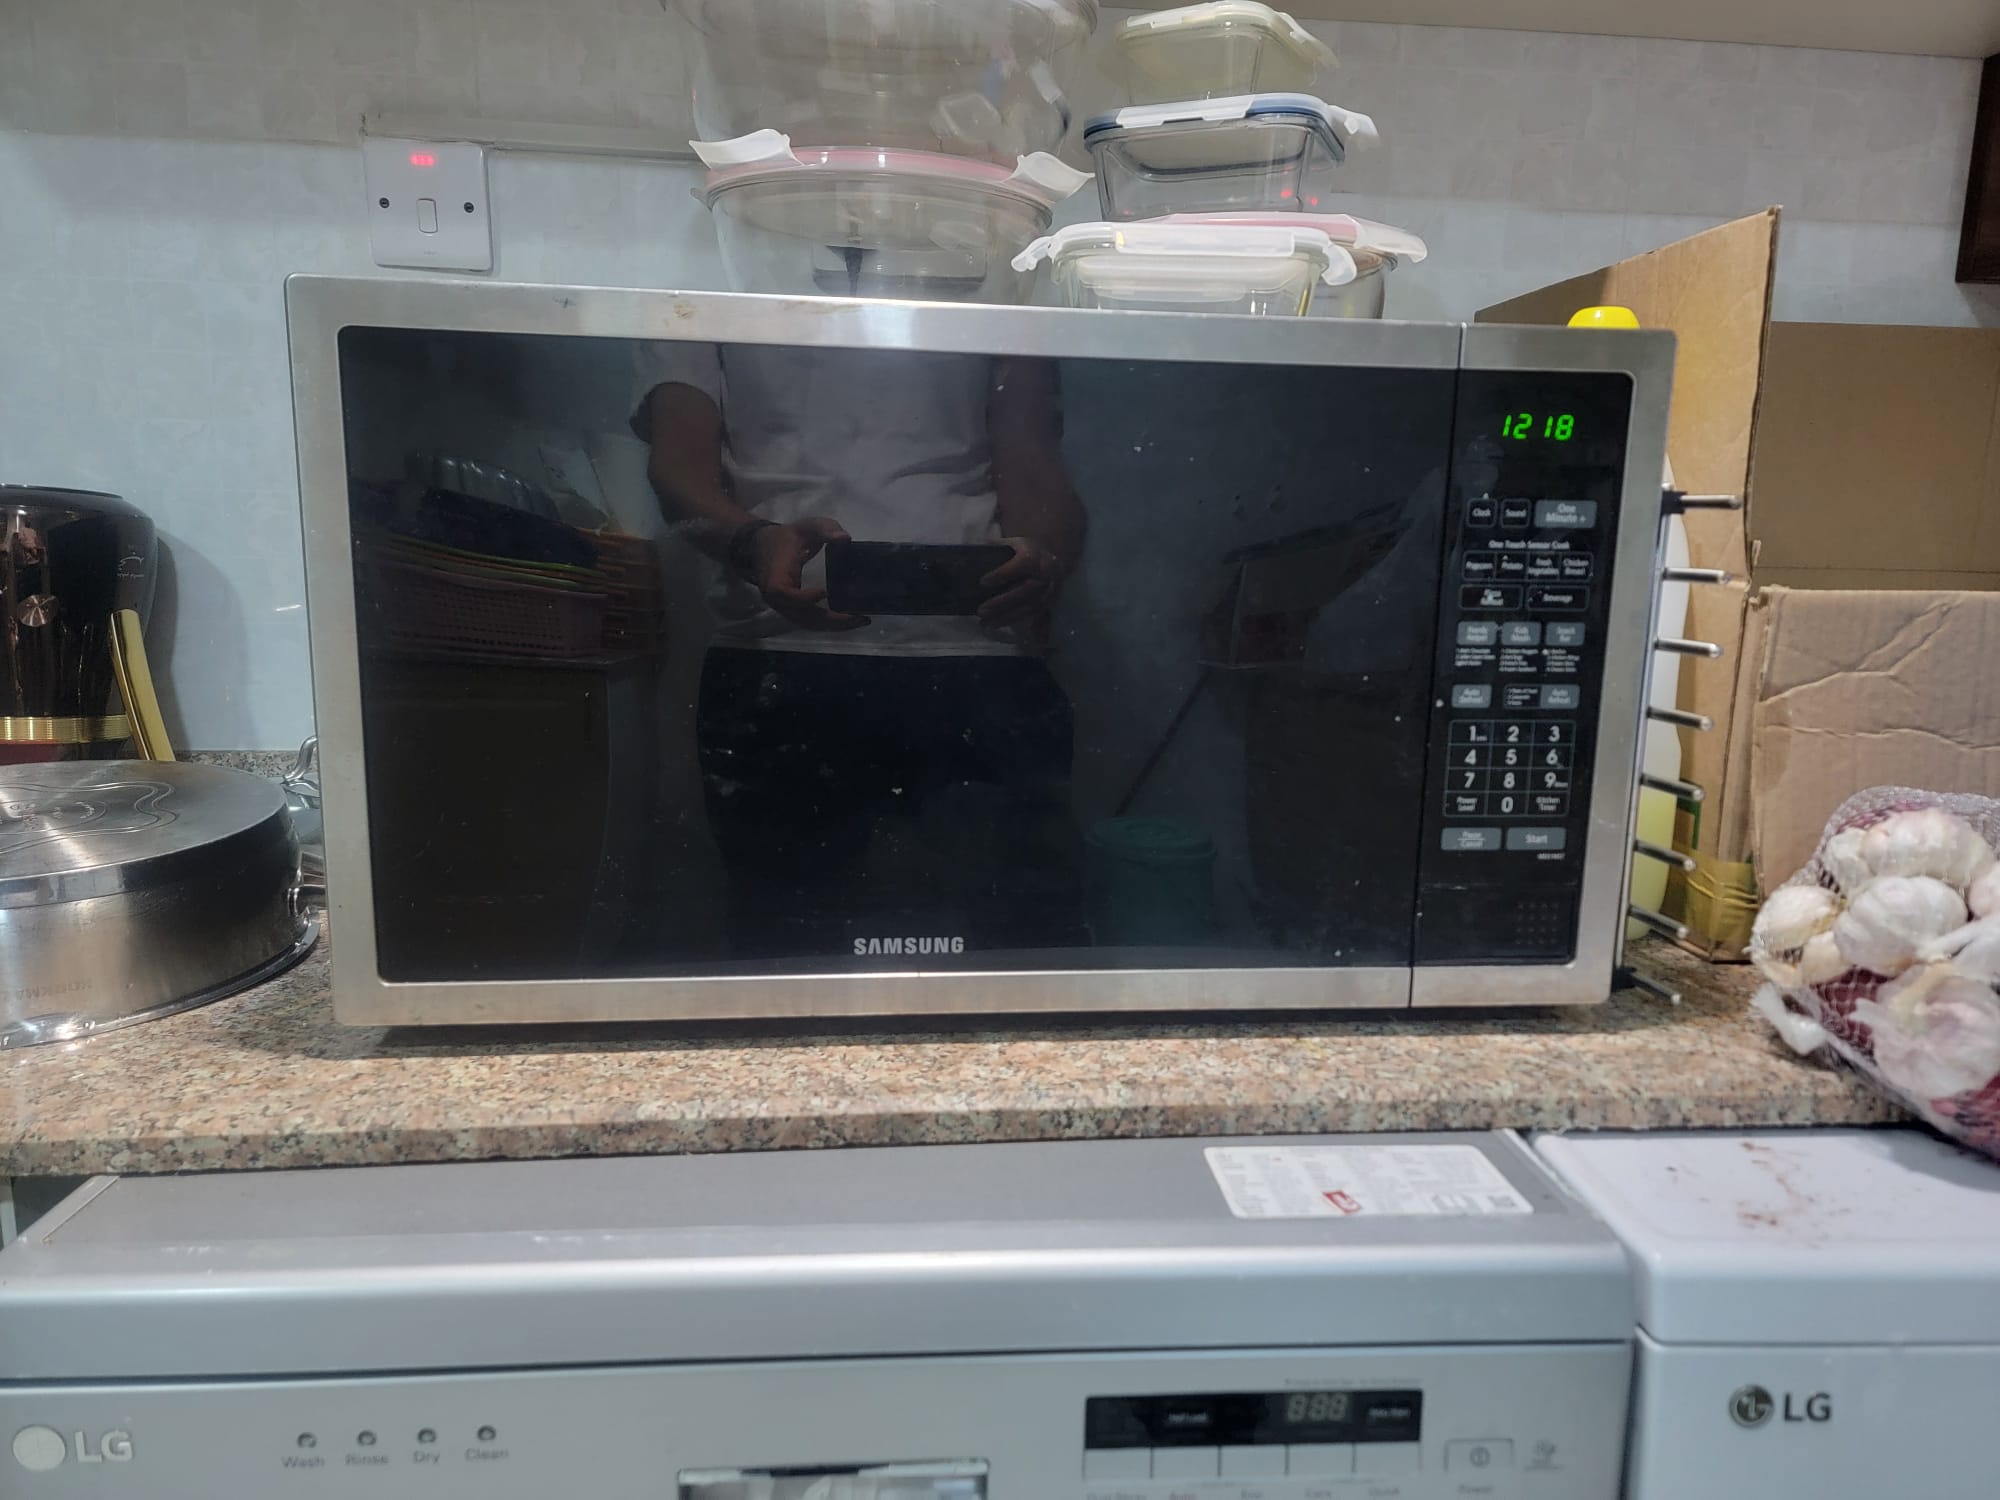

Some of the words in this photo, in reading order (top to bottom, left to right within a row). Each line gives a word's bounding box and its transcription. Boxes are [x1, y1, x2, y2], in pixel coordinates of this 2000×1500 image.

[1558, 503, 1577, 513] One
[1545, 512, 1578, 523] Minute
[1469, 725, 1477, 742] 1
[1507, 725, 1520, 742] 2
[1548, 725, 1561, 742] 3
[1464, 748, 1477, 765] 4
[1505, 748, 1518, 765] 5
[1546, 748, 1559, 765] 6
[1464, 771, 1476, 788] 7
[1503, 771, 1515, 789] 8
[1544, 771, 1557, 788] 9
[1501, 796, 1514, 813] 0
[1525, 833, 1549, 844] Start
[853, 936, 965, 955] SAMSUNG
[1783, 1392, 1831, 1422] LG
[75, 1430, 133, 1463] LG
[464, 1447, 508, 1461] Clean
[281, 1456, 324, 1469] Wash
[345, 1452, 389, 1466] Rinse
[413, 1451, 441, 1465] Dry
